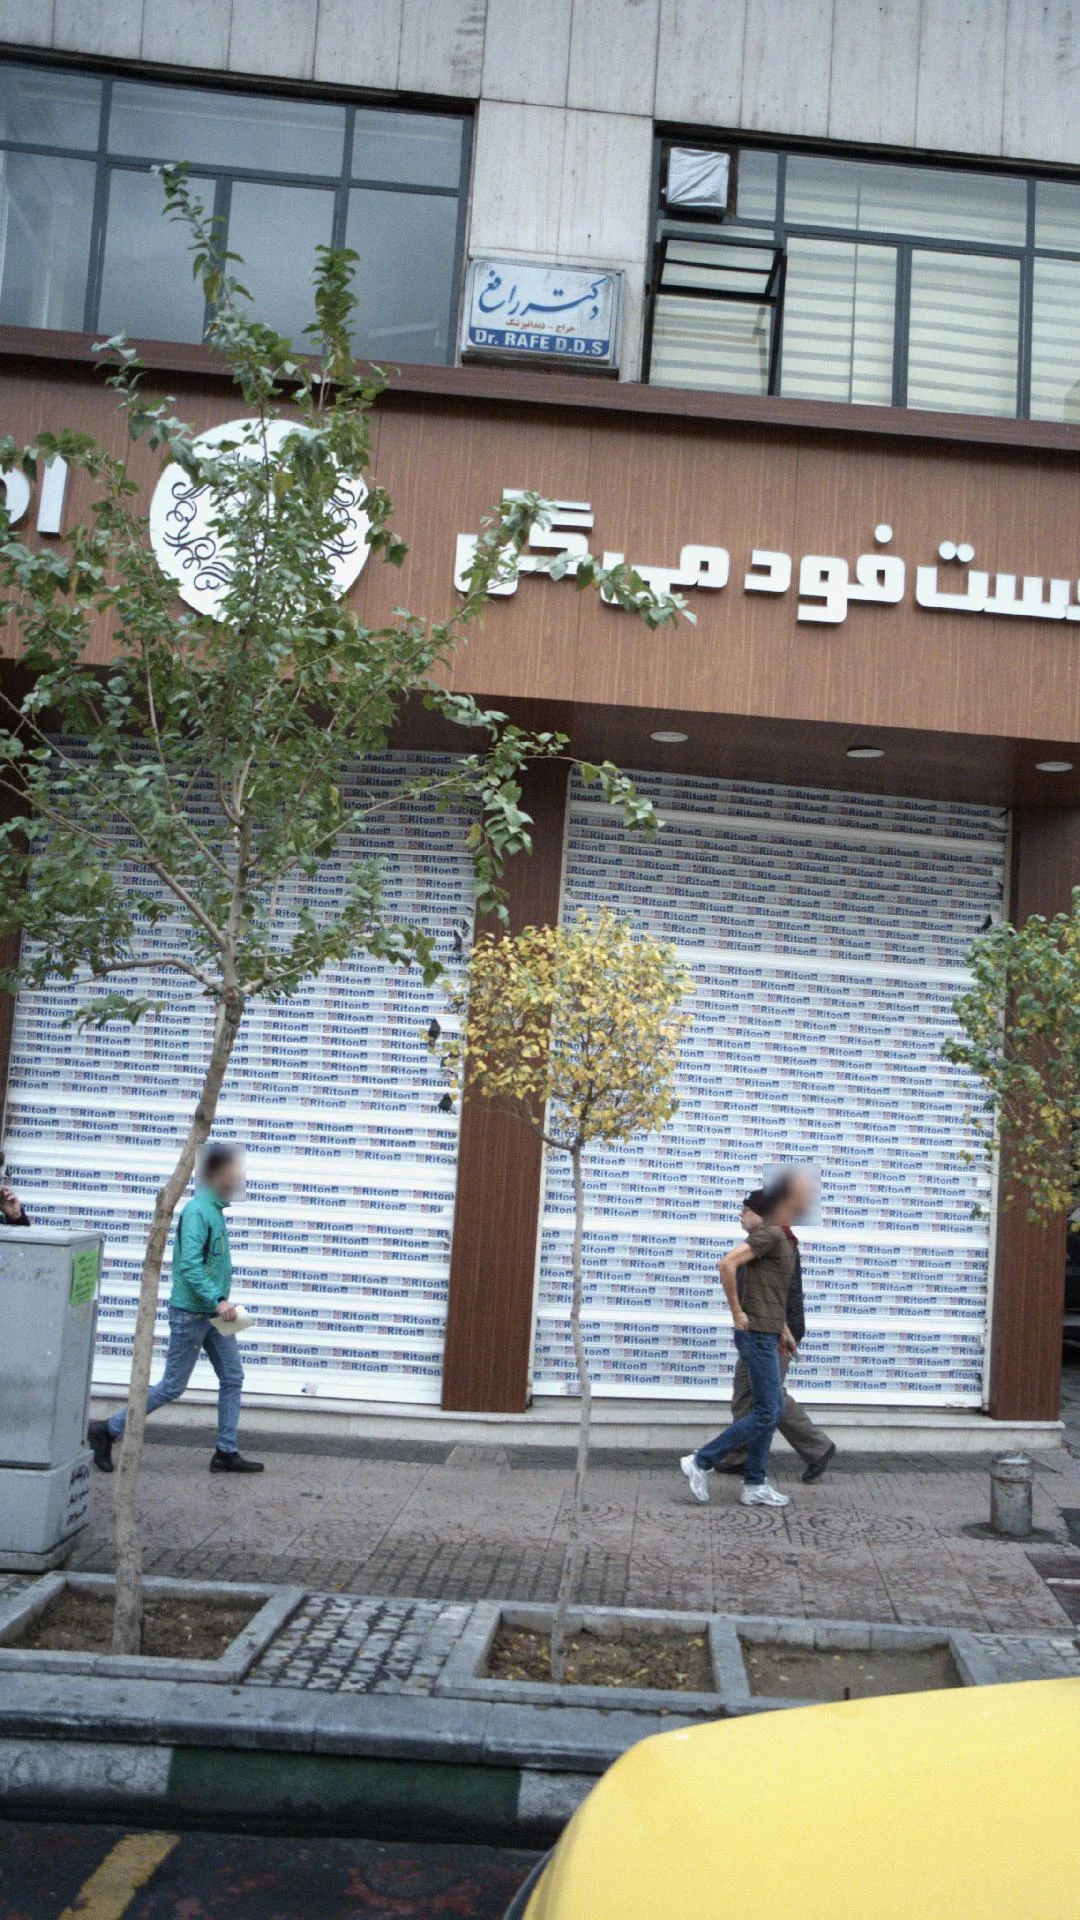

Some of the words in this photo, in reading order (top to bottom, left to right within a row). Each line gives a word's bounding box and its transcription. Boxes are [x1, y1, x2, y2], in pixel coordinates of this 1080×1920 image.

[475, 329, 498, 345] Dr.
[504, 332, 549, 350] RAFE
[744, 524, 905, 623] فود
[914, 540, 1080, 621] ست
[415, 754, 444, 764] Riton
[370, 764, 398, 775] Riton
[680, 803, 707, 813] Riton
[738, 796, 766, 806] Riton
[794, 803, 820, 812] Riton
[848, 808, 875, 818] Riton
[902, 814, 929, 823] Riton
[408, 815, 437, 824] Riton
[414, 828, 442, 838] Riton
[589, 830, 617, 840] Riton
[358, 837, 386, 848] Riton
[417, 840, 445, 851] Riton
[684, 851, 712, 861] Riton
[423, 866, 452, 876] Riton
[131, 877, 159, 886] Riton
[306, 886, 336, 896] Riton
[570, 865, 598, 875] Riton
[851, 892, 877, 902] Riton
[958, 900, 984, 910] Riton
[617, 882, 645, 892] Riton
[731, 893, 757, 903] Riton
[841, 903, 867, 912] Riton
[699, 902, 725, 912] Riton
[756, 907, 782, 917] Riton
[920, 921, 946, 931] Riton
[671, 925, 698, 934] Riton
[152, 940, 181, 950] Riton
[939, 935, 966, 945] Riton
[783, 946, 809, 956] Riton
[348, 964, 378, 974] Riton
[160, 979, 190, 988] Riton
[334, 976, 364, 985] Riton
[394, 979, 422, 988] Riton
[784, 970, 810, 980] Riton
[839, 975, 865, 985] Riton
[894, 979, 920, 989] Riton
[704, 976, 730, 986] Riton
[816, 985, 842, 995] Riton
[925, 993, 951, 1002] Riton
[397, 991, 427, 1001] Riton
[719, 990, 746, 1000] Riton
[776, 994, 802, 1004] Riton
[392, 1004, 422, 1013] Riton
[704, 1001, 731, 1011] Riton
[816, 1009, 842, 1019] Riton
[272, 1022, 302, 1032] Riton
[35, 1033, 65, 1042] Riton
[95, 1036, 122, 1045] Riton
[773, 1043, 799, 1053] Riton
[901, 1040, 928, 1050] Riton
[35, 1045, 64, 1054] Riton
[94, 1048, 123, 1058] Riton
[152, 1052, 182, 1062] Riton
[271, 1047, 301, 1056] Riton
[390, 1054, 420, 1064] Riton
[271, 1059, 301, 1069] Riton
[838, 1060, 865, 1070] Riton
[64, 1059, 93, 1068] Riton
[242, 1069, 272, 1079] Riton
[301, 1073, 331, 1083] Riton
[675, 1061, 703, 1071] Riton
[789, 1068, 815, 1078] Riton
[899, 1076, 925, 1086] Riton
[801, 1082, 827, 1092] Riton
[911, 1088, 937, 1098] Riton
[249, 1095, 279, 1105] Riton
[369, 1102, 399, 1112] Riton
[919, 1102, 945, 1111] Riton
[79, 1109, 108, 1119] Riton
[138, 1112, 168, 1122] Riton
[81, 1121, 111, 1131] Riton
[256, 1120, 286, 1129] Riton
[316, 1123, 346, 1133] Riton
[376, 1126, 406, 1136] Riton
[694, 1112, 721, 1122] Riton
[862, 1122, 889, 1132] Riton
[917, 1125, 943, 1135] Riton
[124, 1136, 154, 1146] Riton
[259, 1132, 289, 1142] Riton
[319, 1136, 349, 1145] Riton
[809, 1131, 836, 1141] Riton
[785, 1142, 811, 1152] Riton
[666, 1148, 693, 1158] Riton
[590, 1156, 617, 1166] Riton
[123, 1173, 153, 1183] Riton
[71, 1182, 101, 1192] Riton
[362, 1187, 391, 1197] Riton
[629, 1184, 657, 1193] Riton
[687, 1187, 715, 1196] Riton
[822, 1181, 849, 1191] Riton
[932, 1187, 958, 1197] Riton
[249, 1193, 279, 1203] Riton
[369, 1201, 399, 1211] Riton
[665, 1198, 692, 1208] Riton
[856, 1195, 882, 1205] Riton
[78, 1208, 107, 1217] Riton
[603, 1208, 631, 1217] Riton
[661, 1211, 689, 1220] Riton
[34, 1217, 64, 1227] Riton
[93, 1221, 123, 1231] Riton
[256, 1219, 286, 1229] Riton
[316, 1222, 346, 1232] Riton
[831, 1218, 857, 1229] Riton
[939, 1224, 966, 1234] Riton
[272, 1232, 301, 1242] Riton
[392, 1239, 422, 1249] Riton
[583, 1232, 610, 1242] Riton
[921, 1247, 947, 1257] Riton
[112, 1260, 142, 1269] Riton
[808, 1255, 835, 1265] Riton
[629, 1260, 657, 1269] Riton
[687, 1262, 715, 1272] Riton
[351, 1275, 380, 1285] Riton
[910, 1271, 936, 1281] Riton
[251, 1281, 281, 1291] Riton
[371, 1288, 401, 1298] Riton
[824, 1280, 850, 1290] Riton
[102, 1296, 132, 1306] Riton
[615, 1297, 643, 1306] Riton
[674, 1300, 701, 1309] Riton
[848, 1293, 874, 1303] Riton
[282, 1308, 311, 1318] Riton
[951, 1309, 977, 1318] Riton
[266, 1320, 296, 1329] Riton
[387, 1327, 417, 1337] Riton
[101, 1334, 131, 1344] Riton
[623, 1336, 652, 1345] Riton
[907, 1332, 933, 1342] Riton
[281, 1345, 311, 1355] Riton
[402, 1353, 432, 1362] Riton
[632, 1349, 660, 1358] Riton
[691, 1351, 719, 1360] Riton
[291, 1359, 320, 1368] Riton
[806, 1354, 832, 1364] Riton
[861, 1355, 888, 1366] Riton
[623, 1374, 653, 1384] Riton
[797, 1378, 823, 1389] Riton
[853, 1380, 879, 1390] Riton
[908, 1382, 934, 1392] Riton
